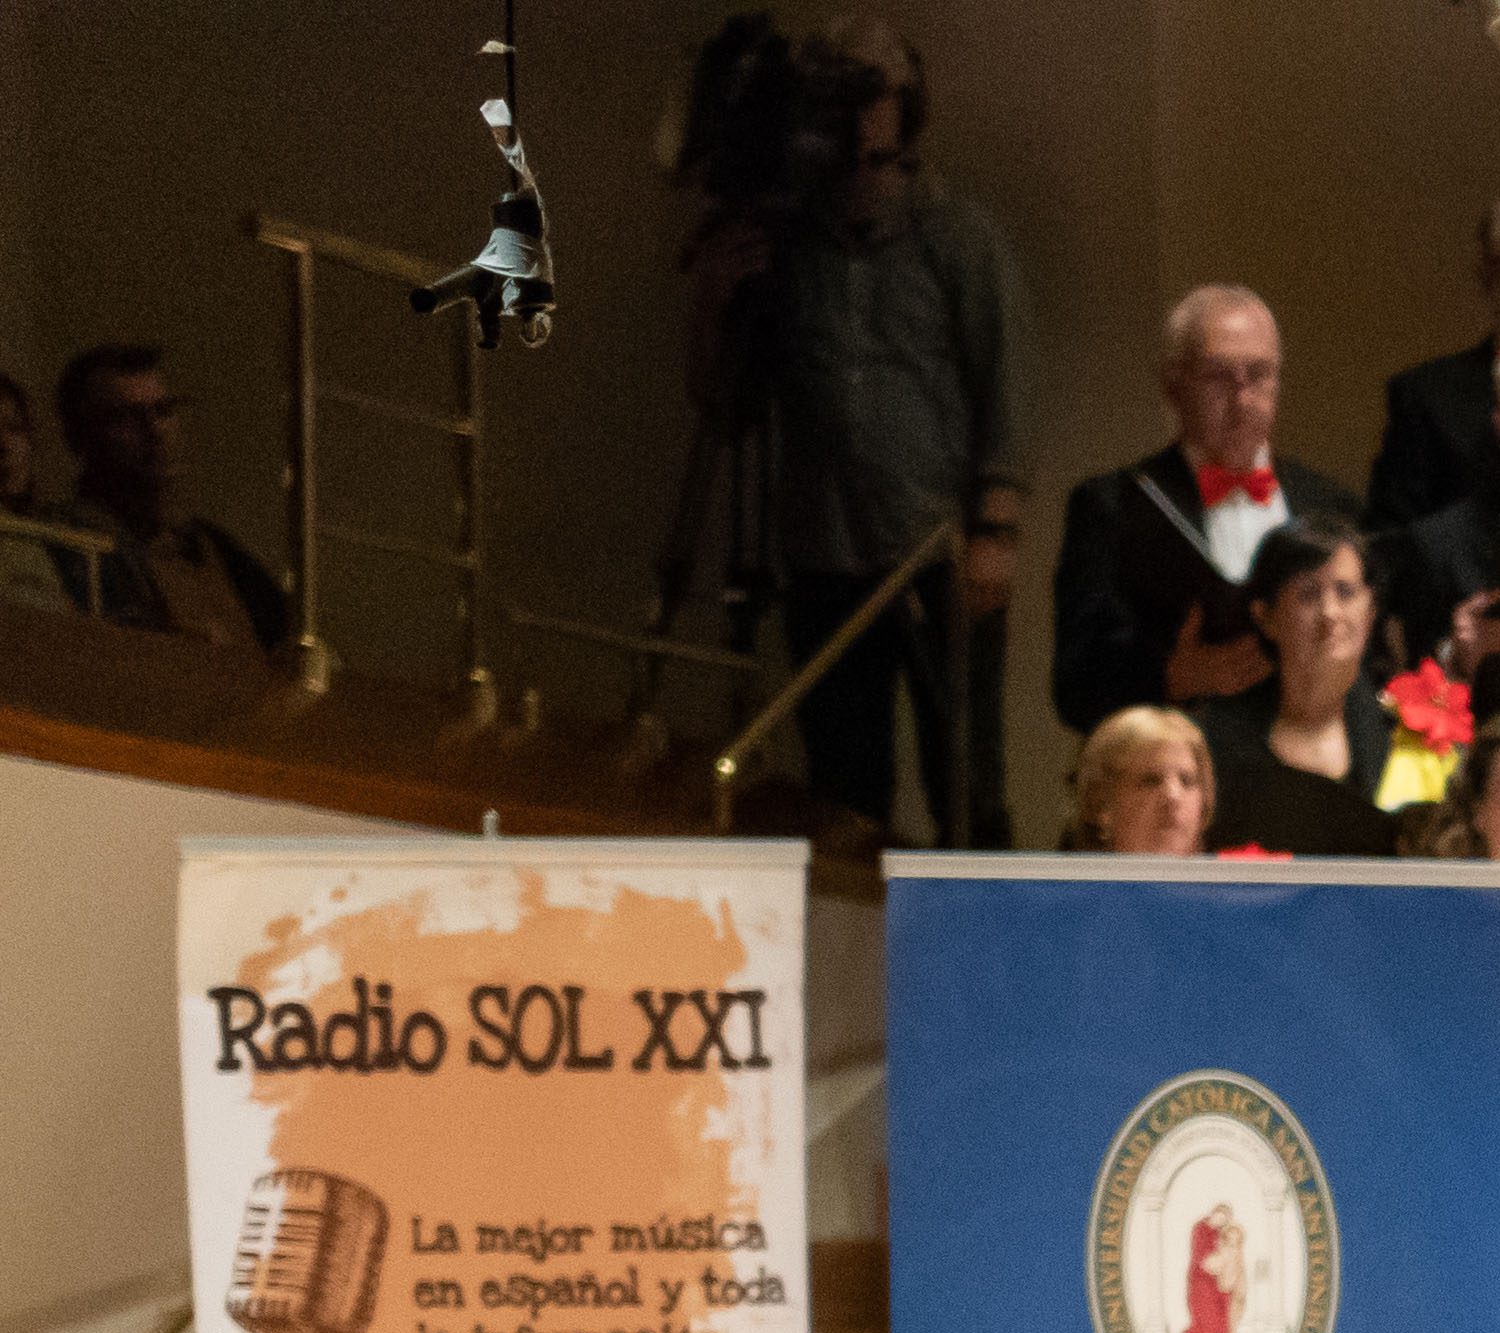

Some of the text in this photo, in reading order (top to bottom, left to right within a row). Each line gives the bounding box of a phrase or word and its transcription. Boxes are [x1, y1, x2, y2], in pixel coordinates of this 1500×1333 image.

[207, 976, 772, 1076] Radio SOL XXI
[412, 1213, 766, 1264] La mejor música
[414, 1265, 786, 1319] en español y toda
